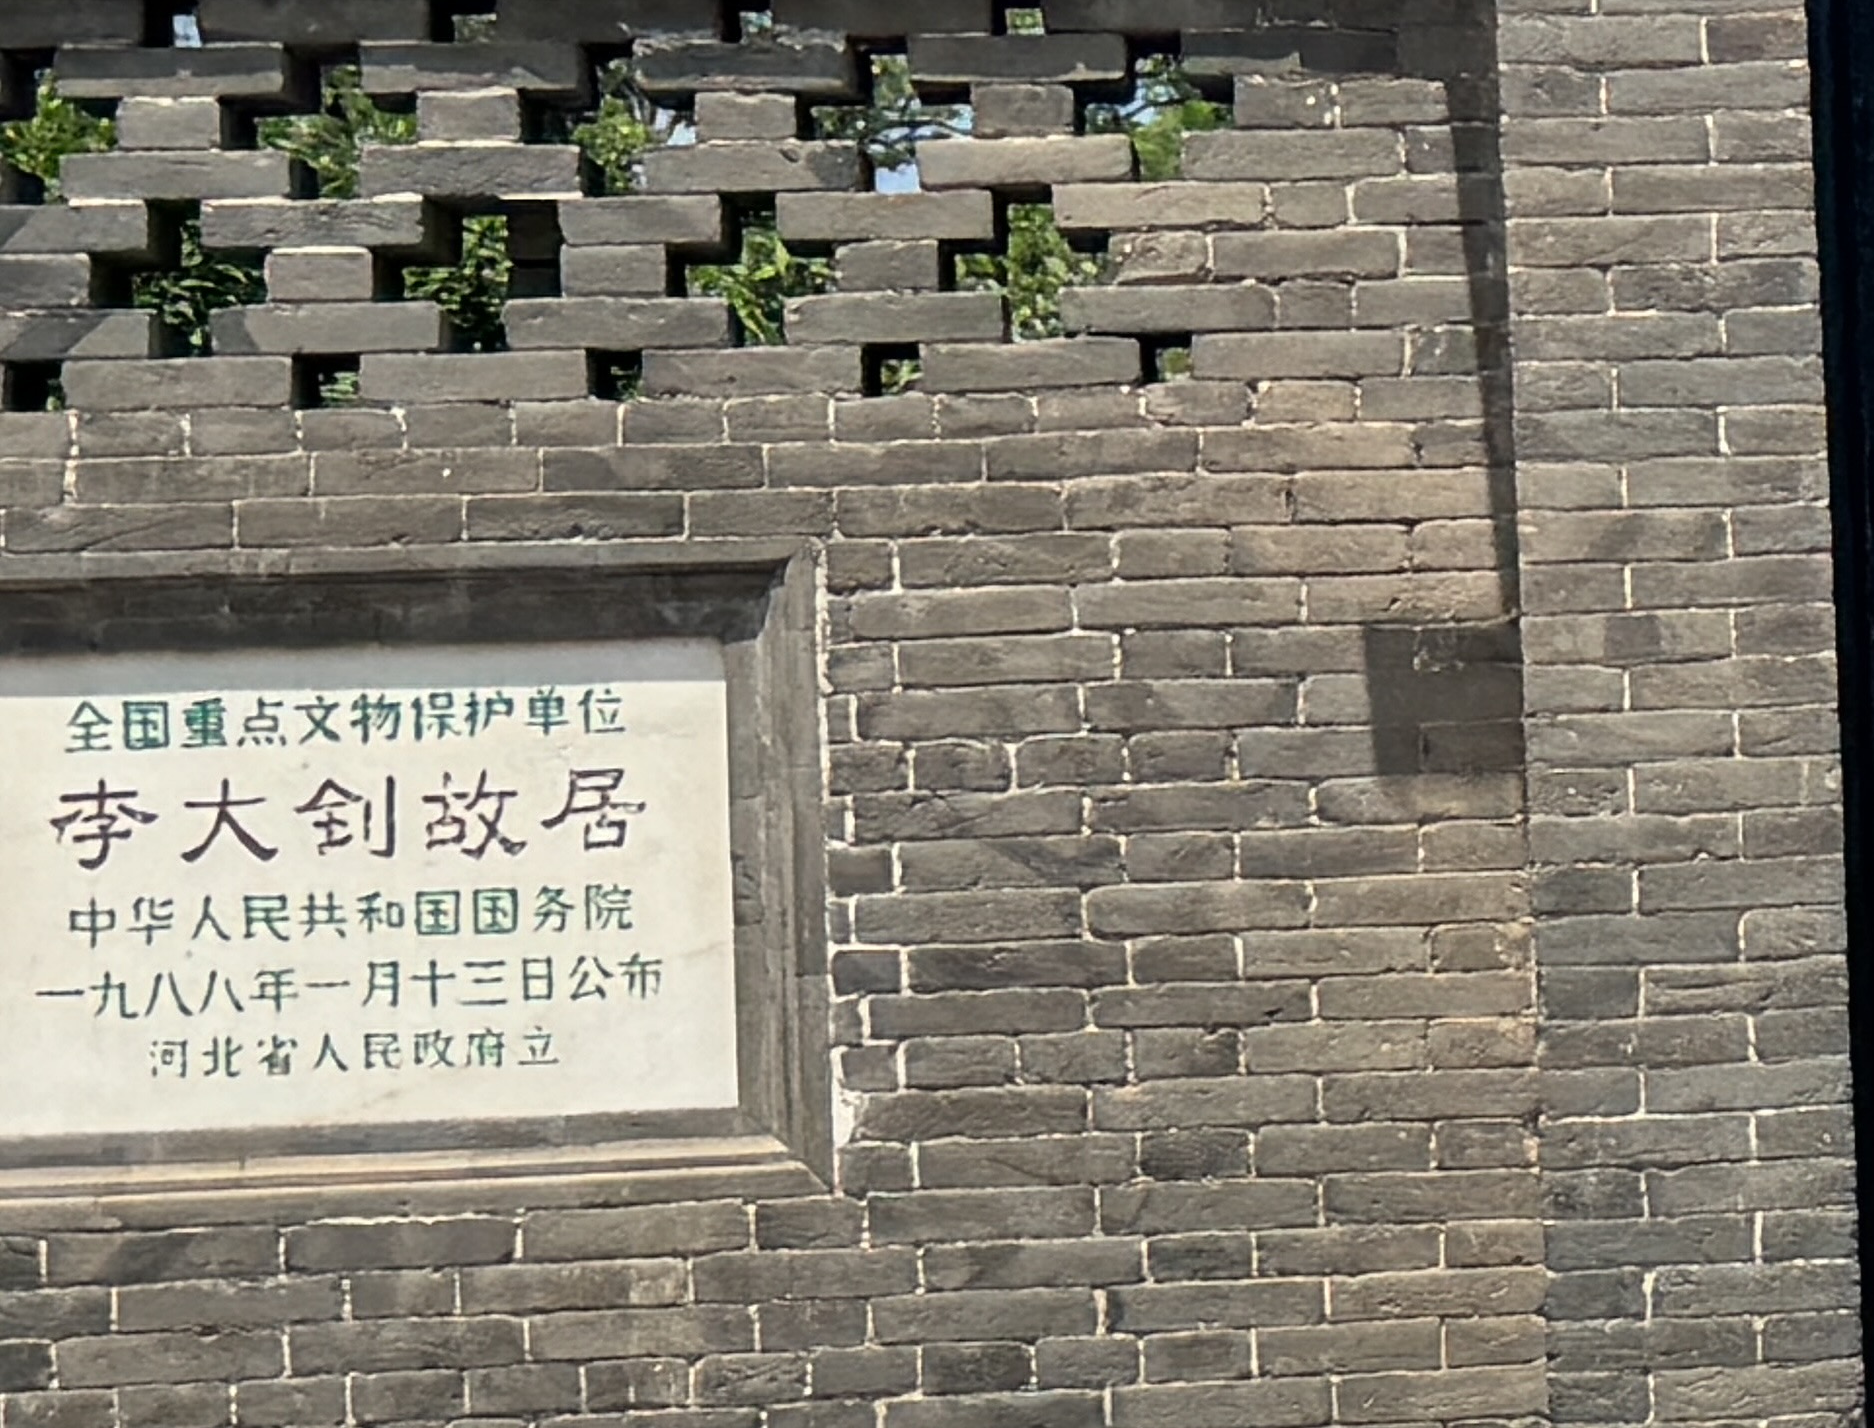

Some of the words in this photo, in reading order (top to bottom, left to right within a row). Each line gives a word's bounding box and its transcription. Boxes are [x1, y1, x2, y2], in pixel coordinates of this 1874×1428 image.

[63, 687, 627, 755] 全国重点文物保护单位
[48, 766, 648, 871] 李大钊故居
[68, 882, 635, 949] 中华人民共和国国务院
[35, 953, 665, 1021] 一九八八年一月十三日公布
[148, 1025, 561, 1081] 河北省人民政府立
